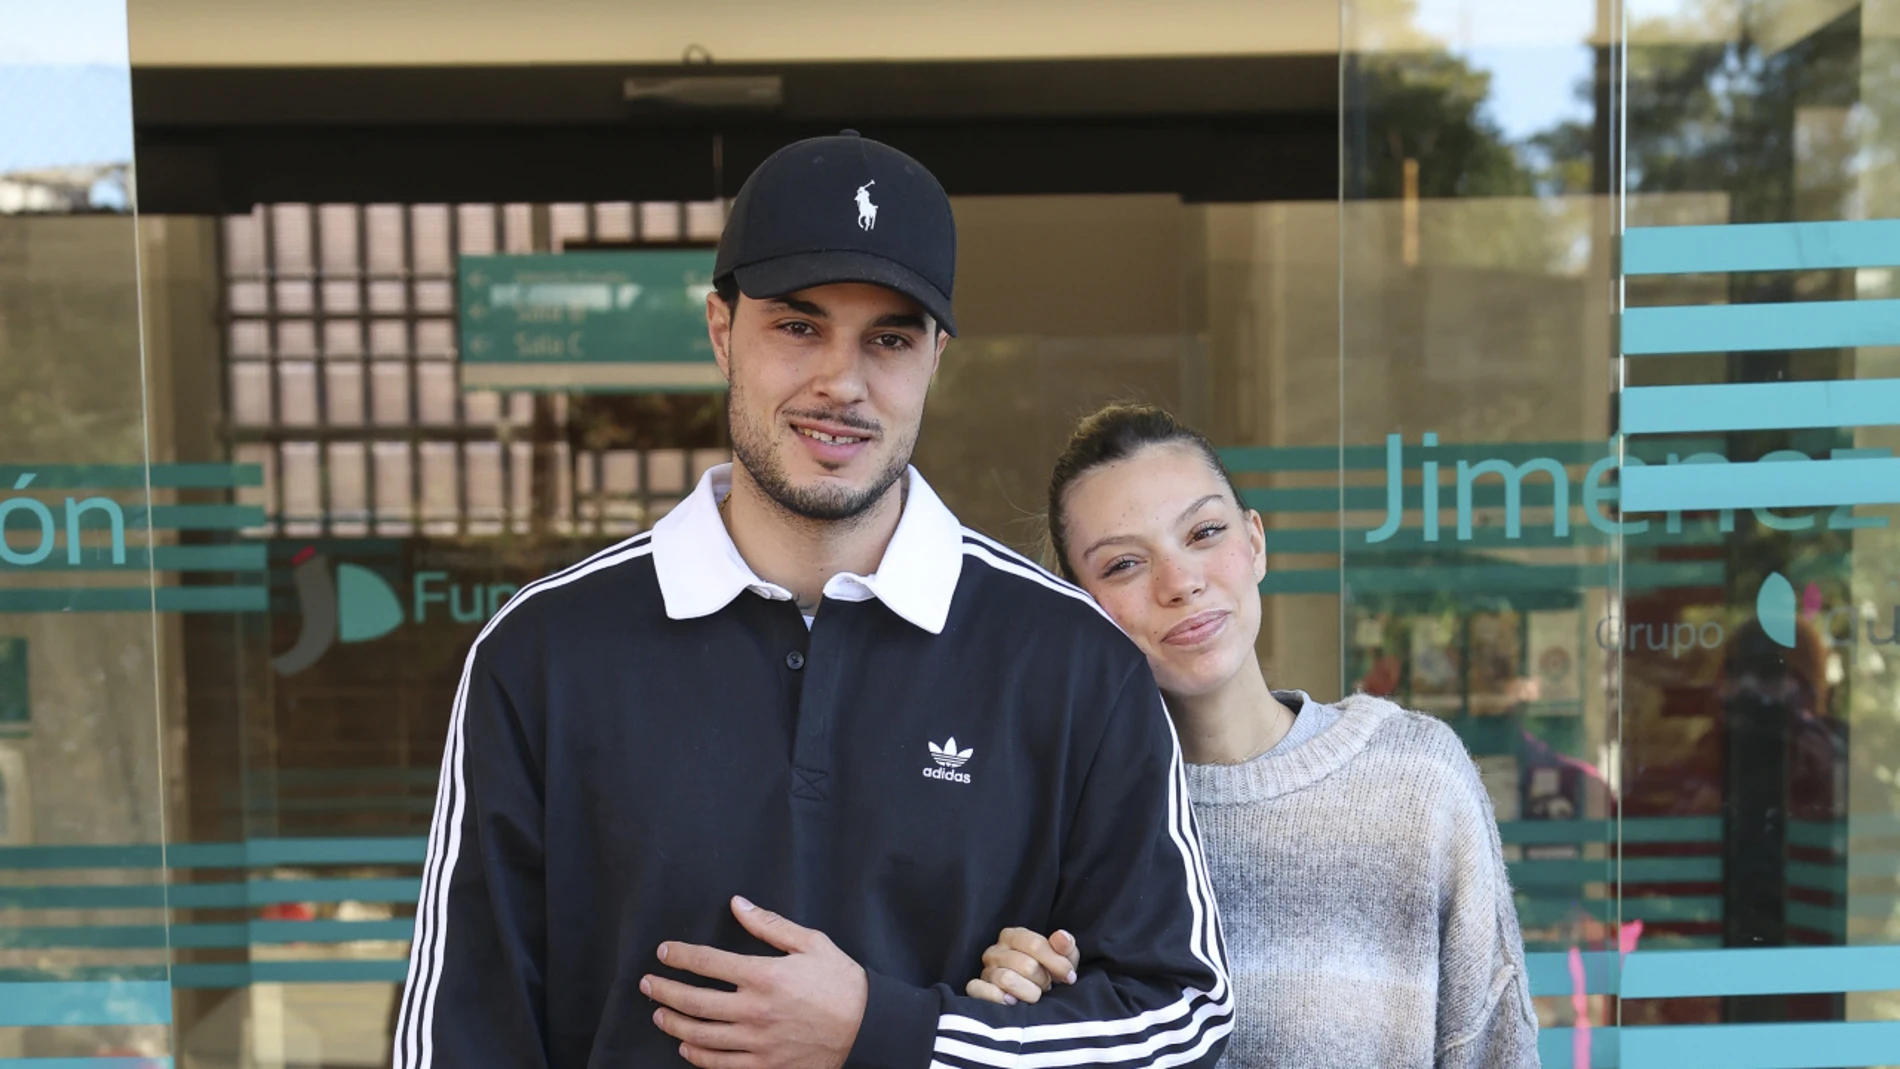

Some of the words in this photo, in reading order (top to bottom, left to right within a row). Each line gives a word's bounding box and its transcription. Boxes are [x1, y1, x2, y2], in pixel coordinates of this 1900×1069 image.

[0, 472, 125, 565] ón
[1595, 614, 1724, 659] Grupo
[922, 767, 971, 784] adidas
